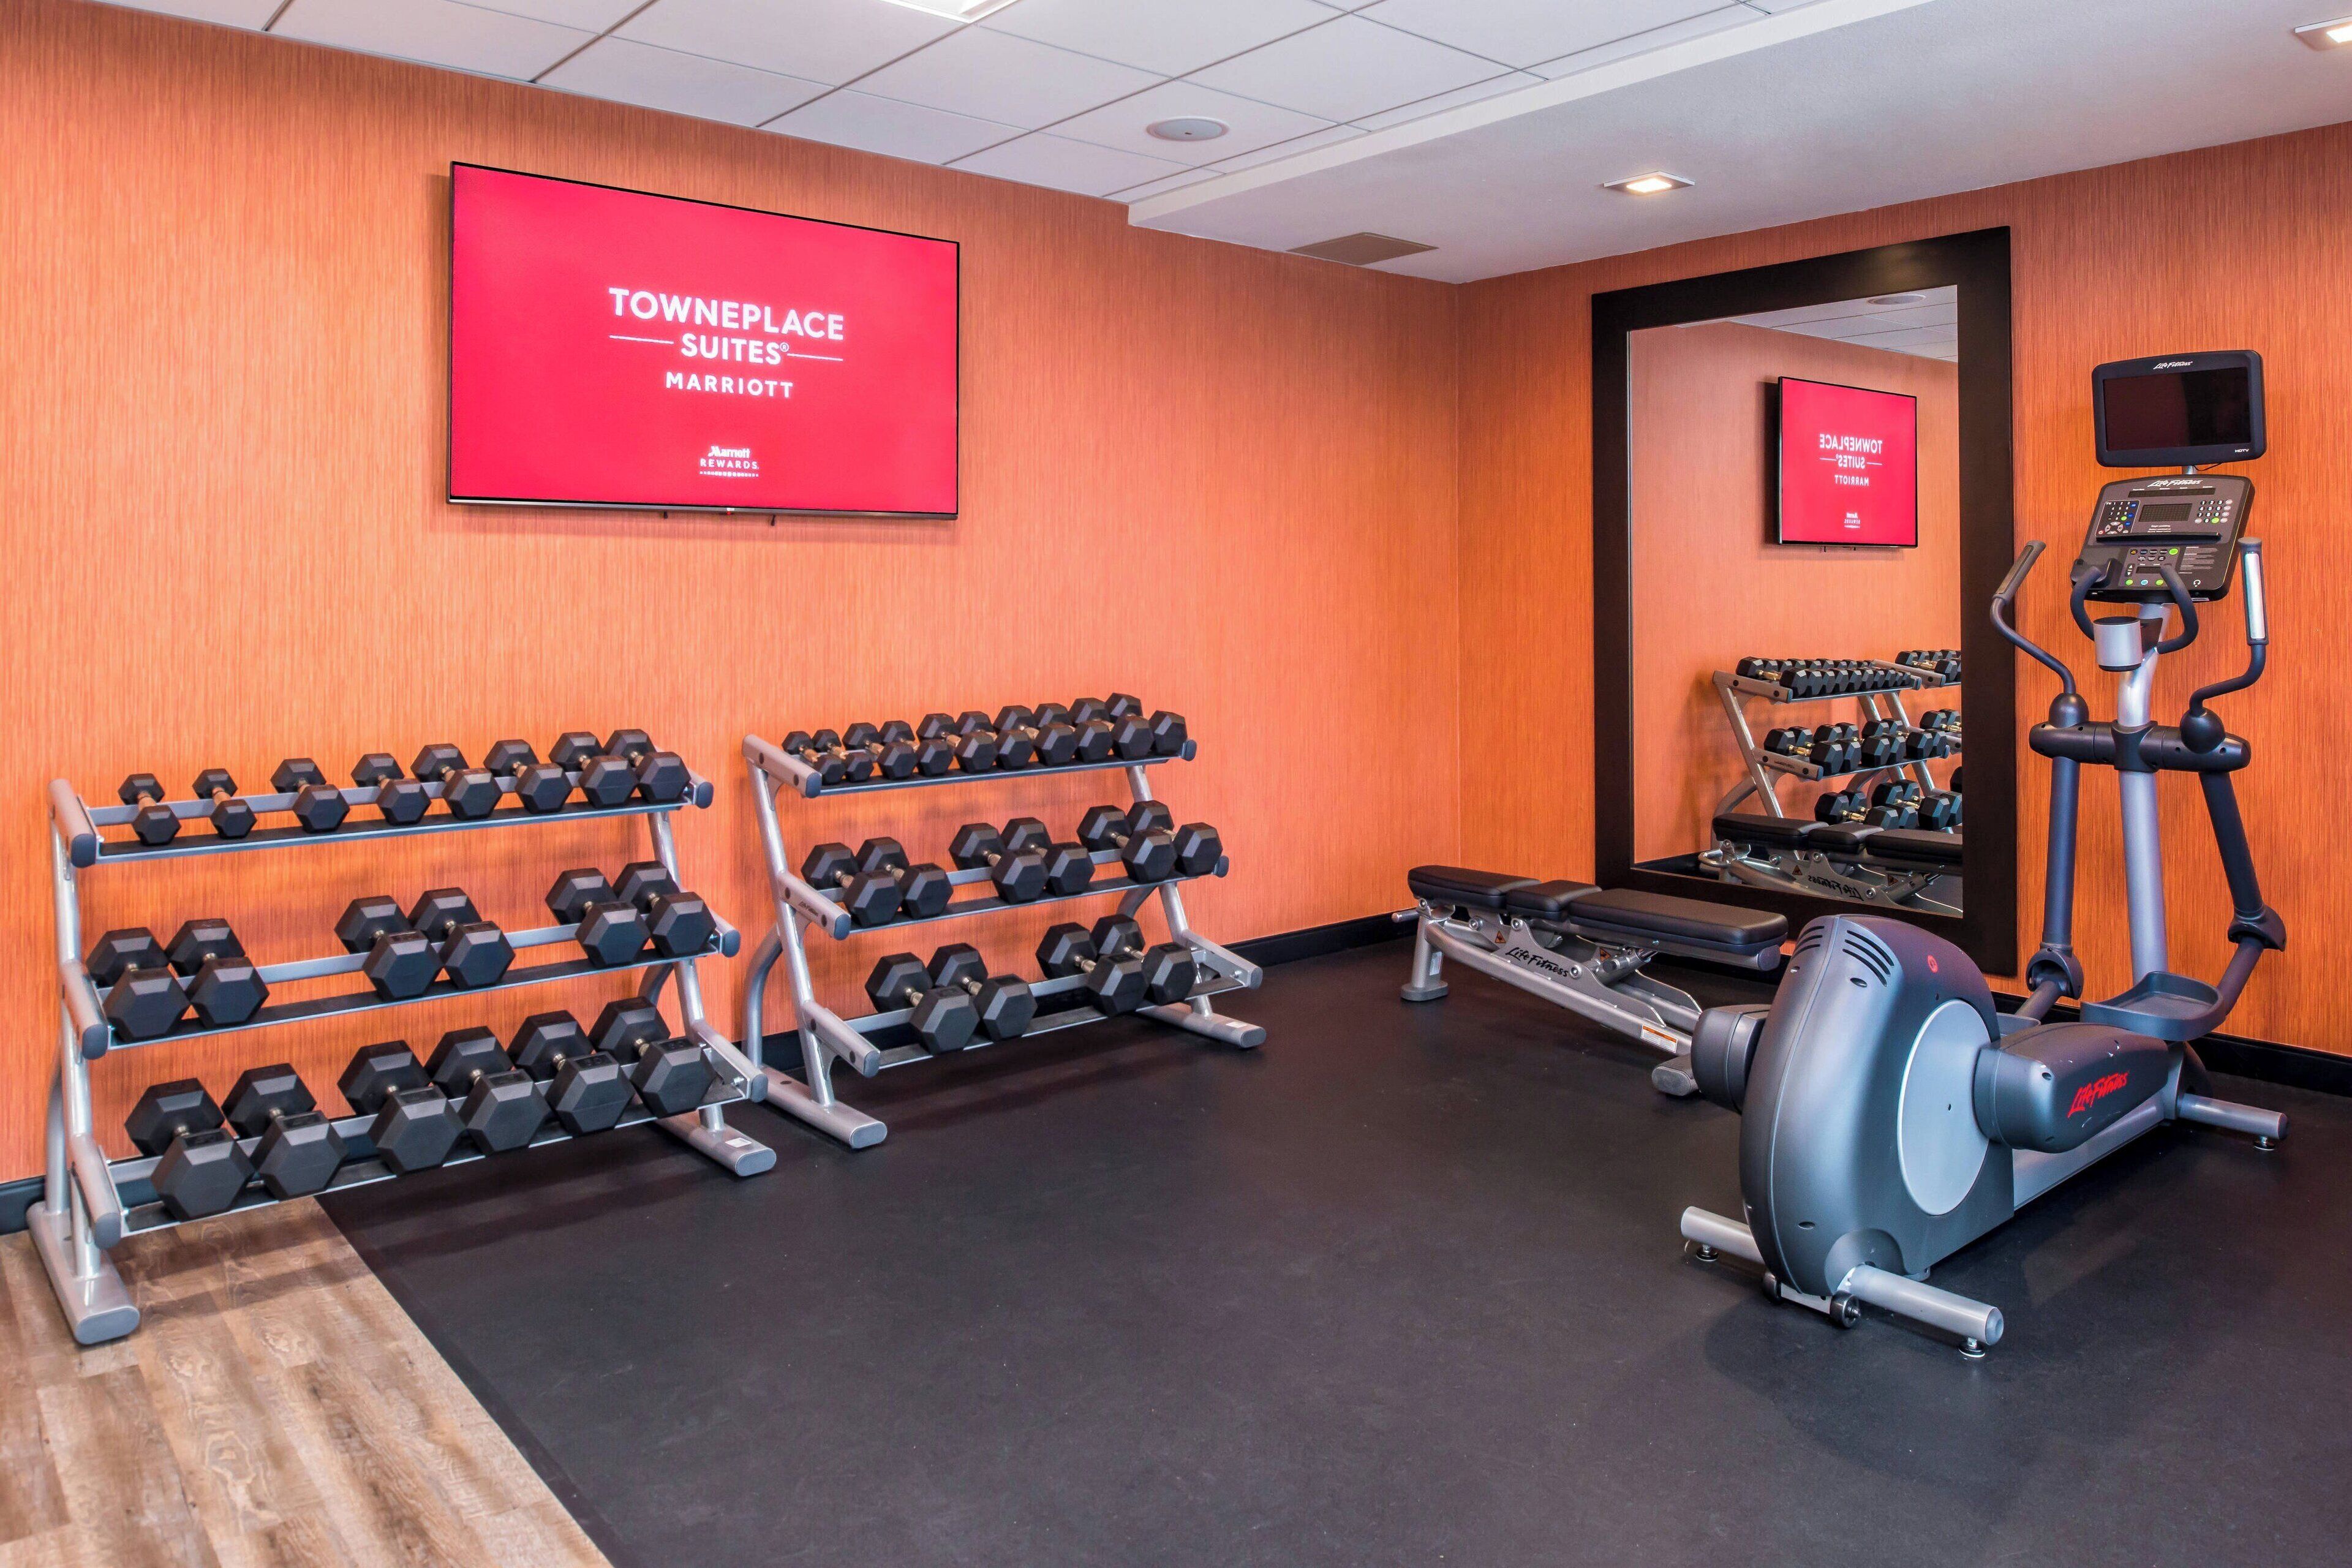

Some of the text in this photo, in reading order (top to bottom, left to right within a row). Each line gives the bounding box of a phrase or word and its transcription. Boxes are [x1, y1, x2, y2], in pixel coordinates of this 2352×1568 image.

[609, 287, 844, 341] TOWNEPLACE
[666, 371, 793, 398] MARRIOTT
[708, 446, 750, 458] Marriott
[1505, 947, 1569, 978] Life Fitness
